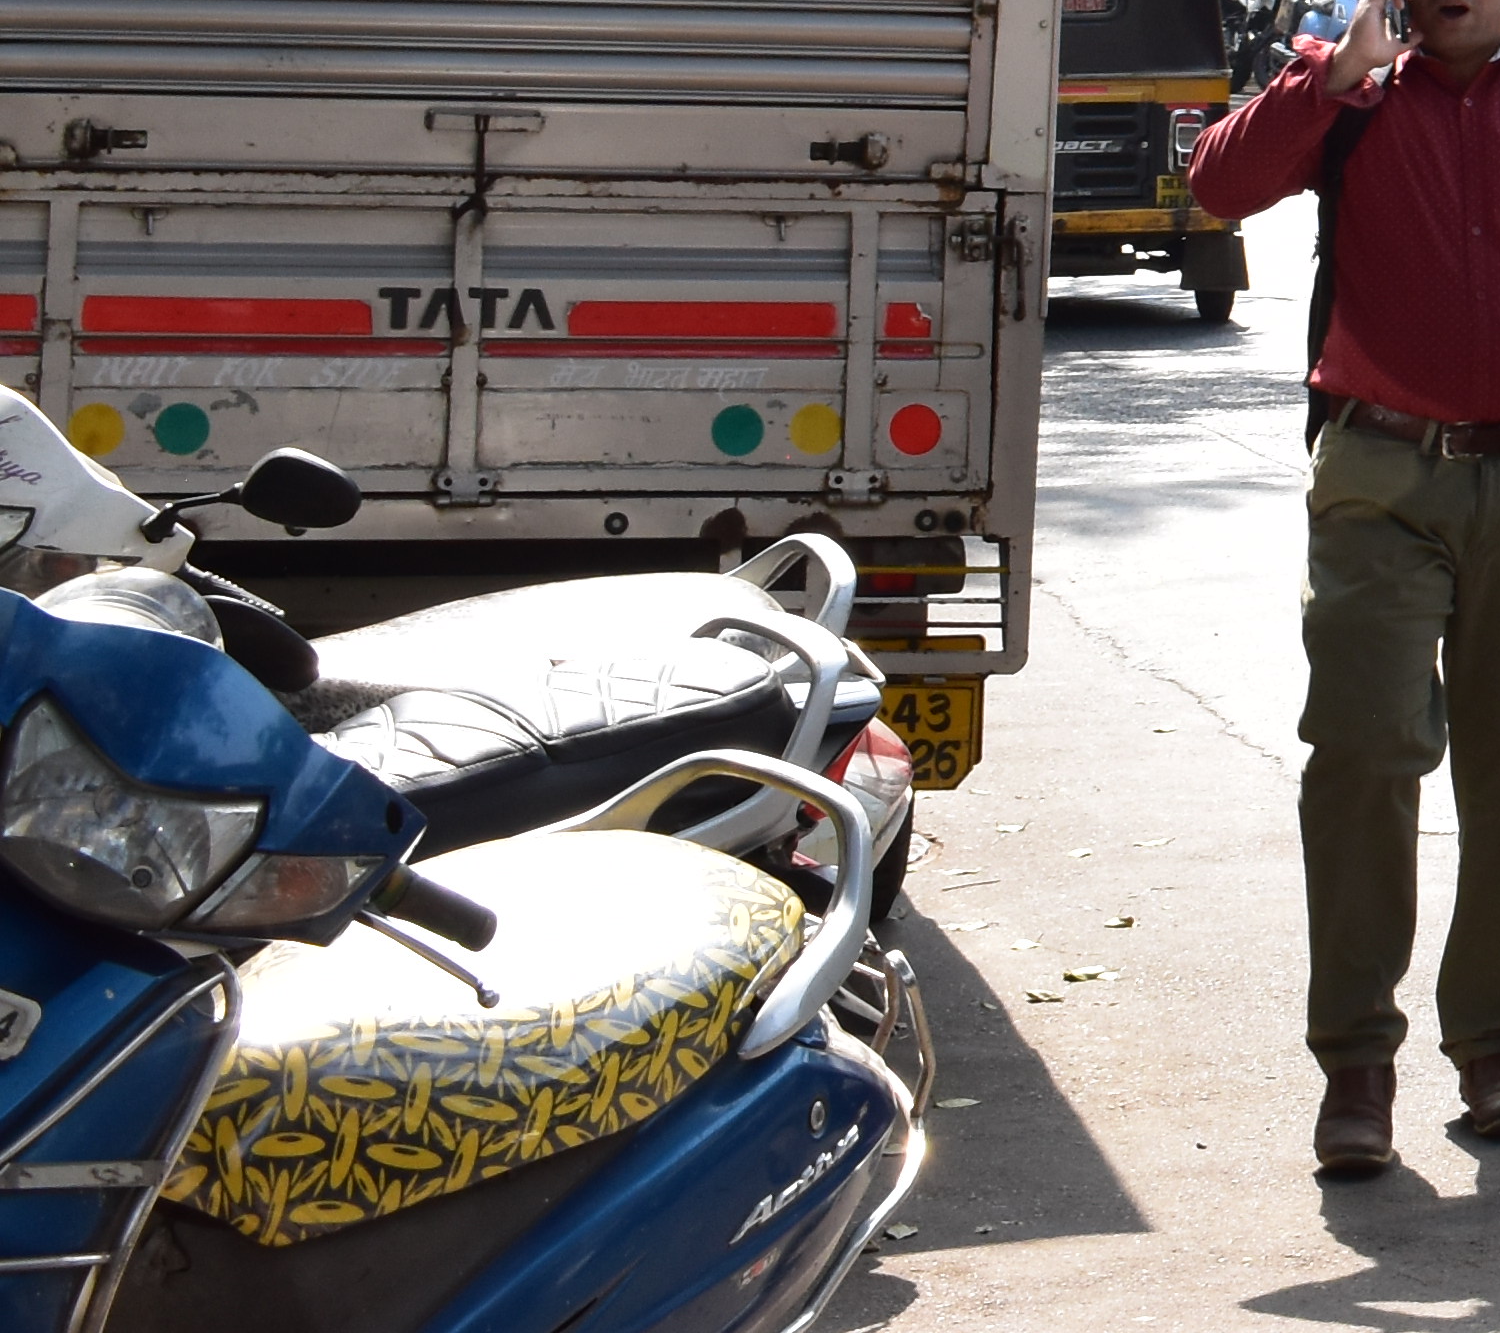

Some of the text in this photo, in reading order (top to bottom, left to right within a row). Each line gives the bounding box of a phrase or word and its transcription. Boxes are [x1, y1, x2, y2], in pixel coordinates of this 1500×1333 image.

[378, 287, 555, 331] TATA
[909, 738, 962, 781] 26
[728, 1123, 860, 1246] Activa
